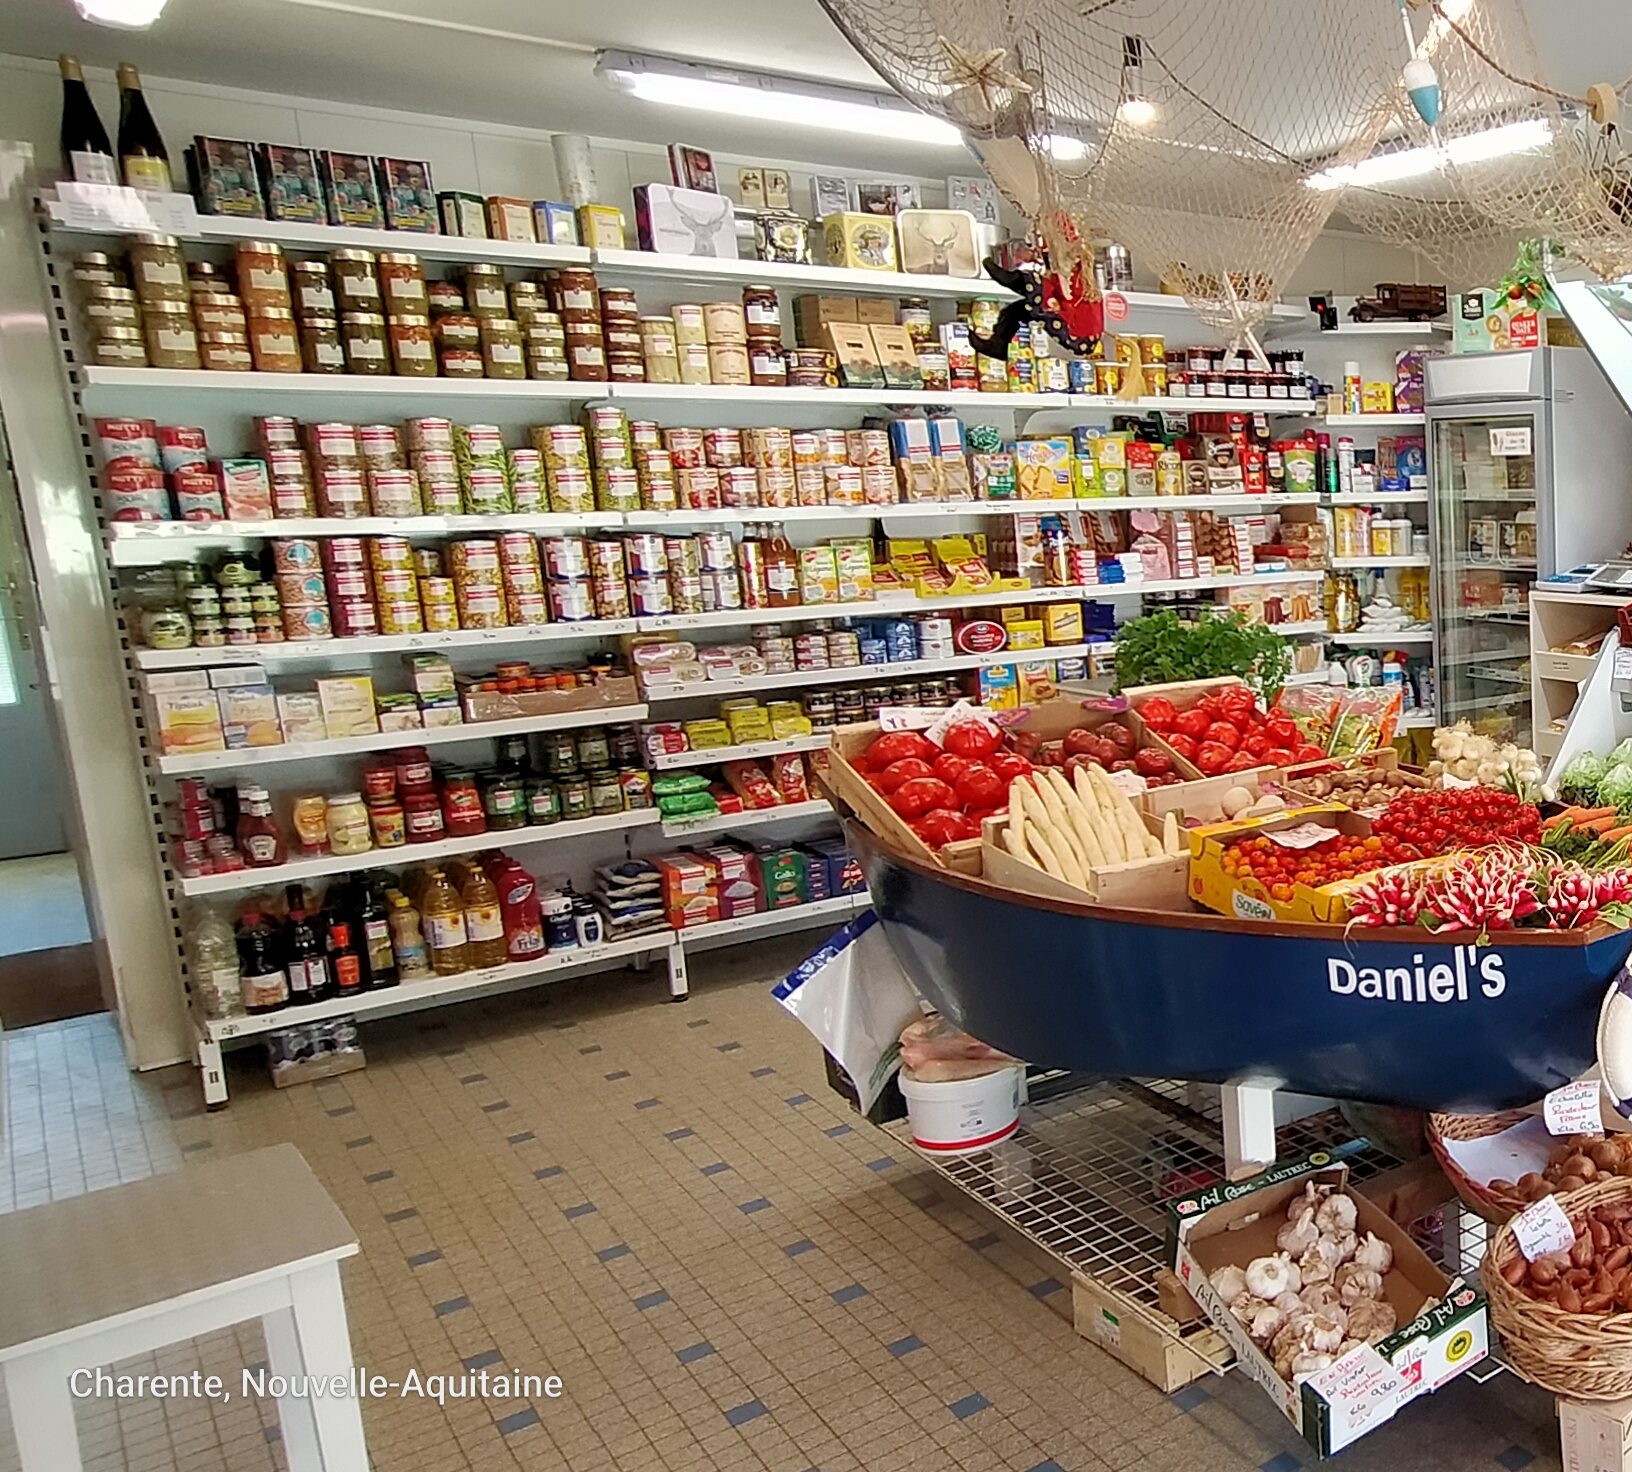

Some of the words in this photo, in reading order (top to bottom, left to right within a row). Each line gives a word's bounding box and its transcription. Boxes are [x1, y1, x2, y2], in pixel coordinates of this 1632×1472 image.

[1235, 894, 1273, 920] Savéol
[1200, 1187, 1221, 1211] Ail
[1224, 1184, 1255, 1201] Rose
[1266, 1161, 1312, 1184] LAUTREC
[1399, 1316, 1432, 1339] Rose
